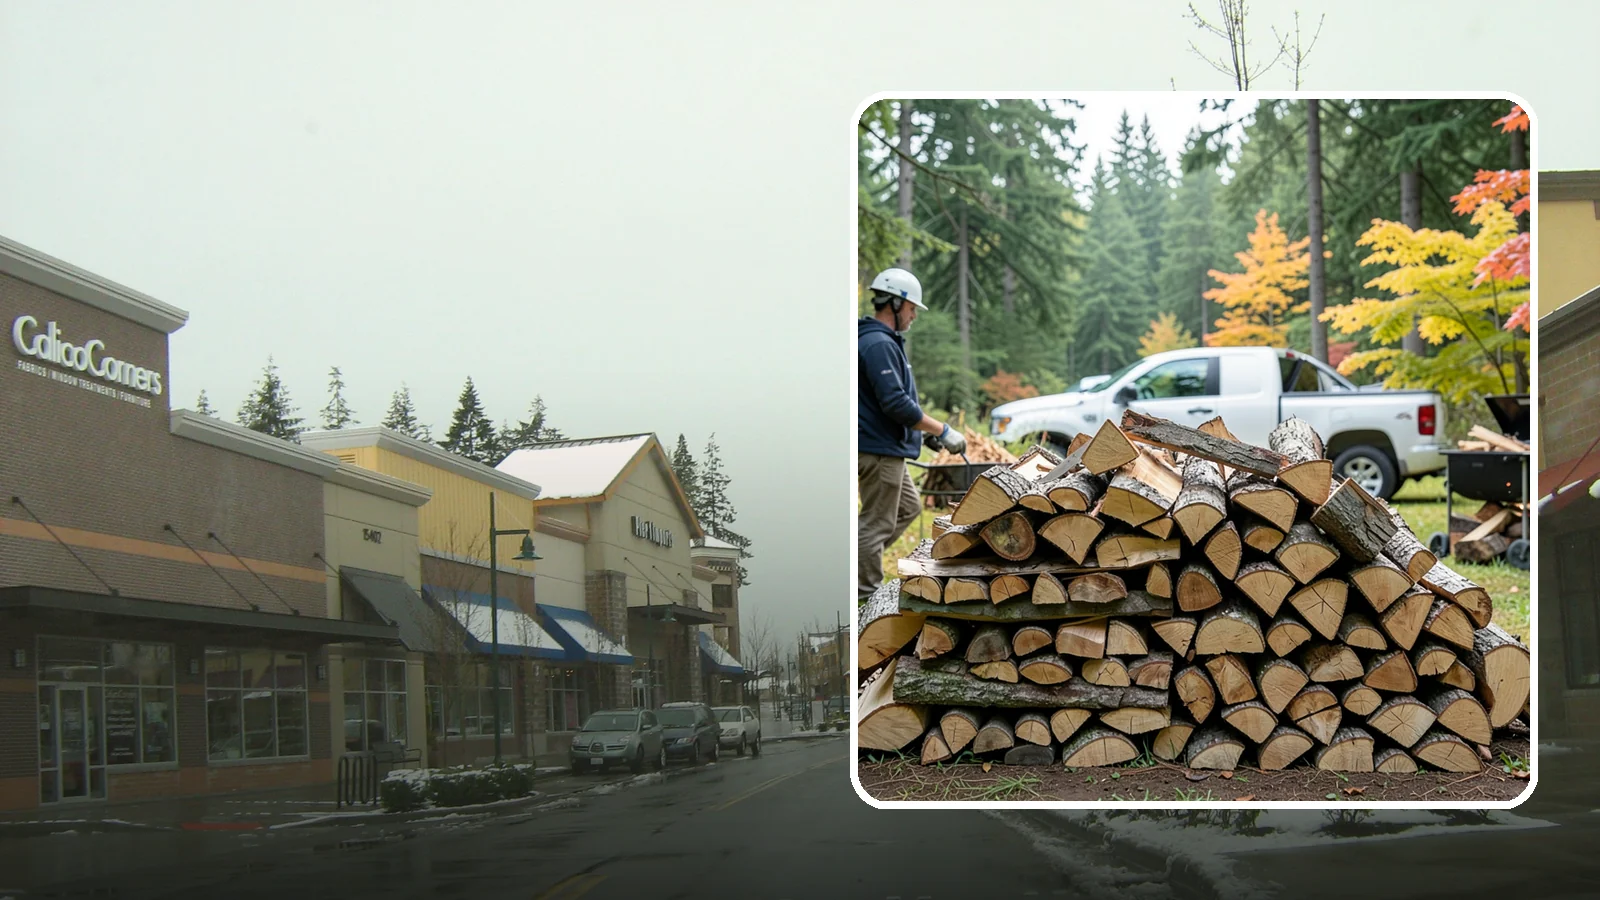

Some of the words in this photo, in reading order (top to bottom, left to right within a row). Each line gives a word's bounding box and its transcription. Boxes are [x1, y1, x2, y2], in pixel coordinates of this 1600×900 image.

[17, 360, 47, 378] FABRICS
[51, 370, 78, 387] WINDOW
[79, 378, 116, 398] TREATMENTS
[120, 391, 151, 409] FURNITURE
